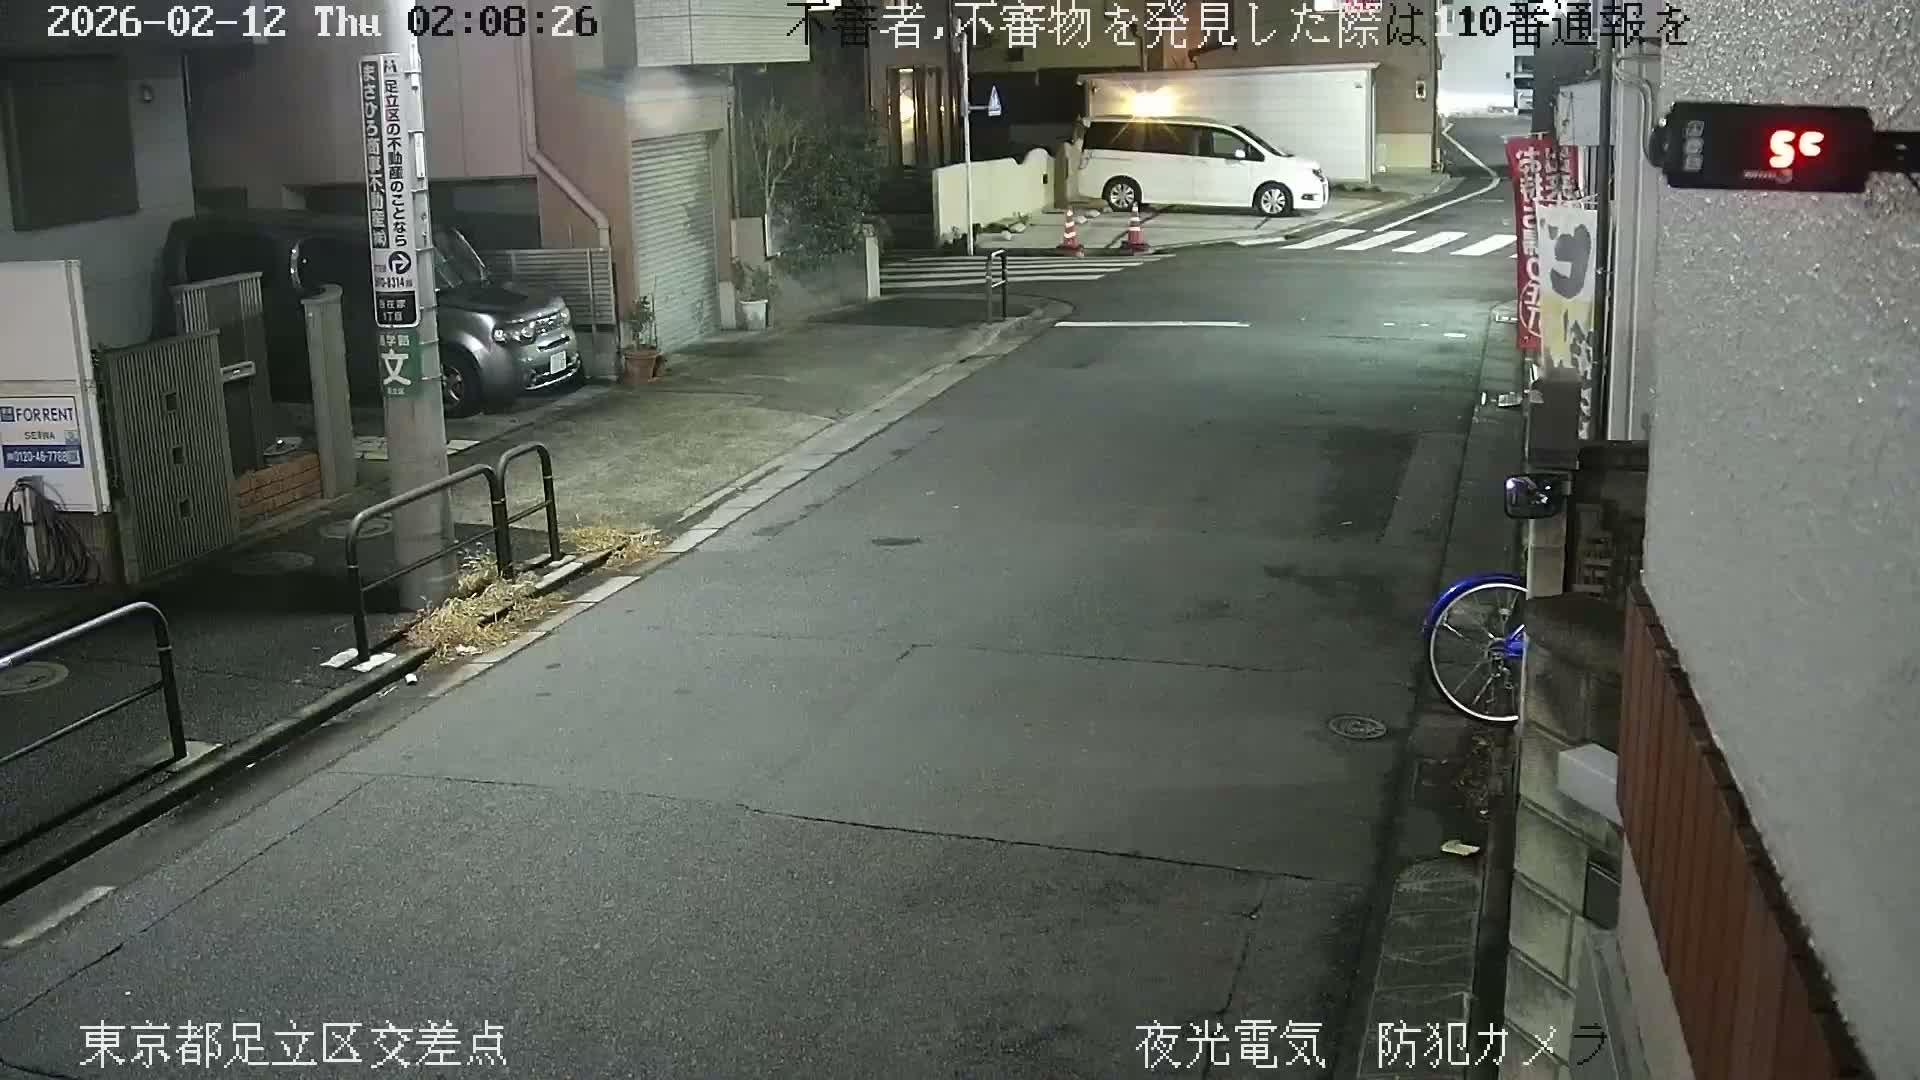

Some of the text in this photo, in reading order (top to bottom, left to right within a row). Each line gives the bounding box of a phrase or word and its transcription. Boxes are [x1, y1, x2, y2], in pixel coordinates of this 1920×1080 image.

[381, 348, 411, 386] 文
[16, 408, 41, 422] FOR
[43, 407, 73, 421] RENT
